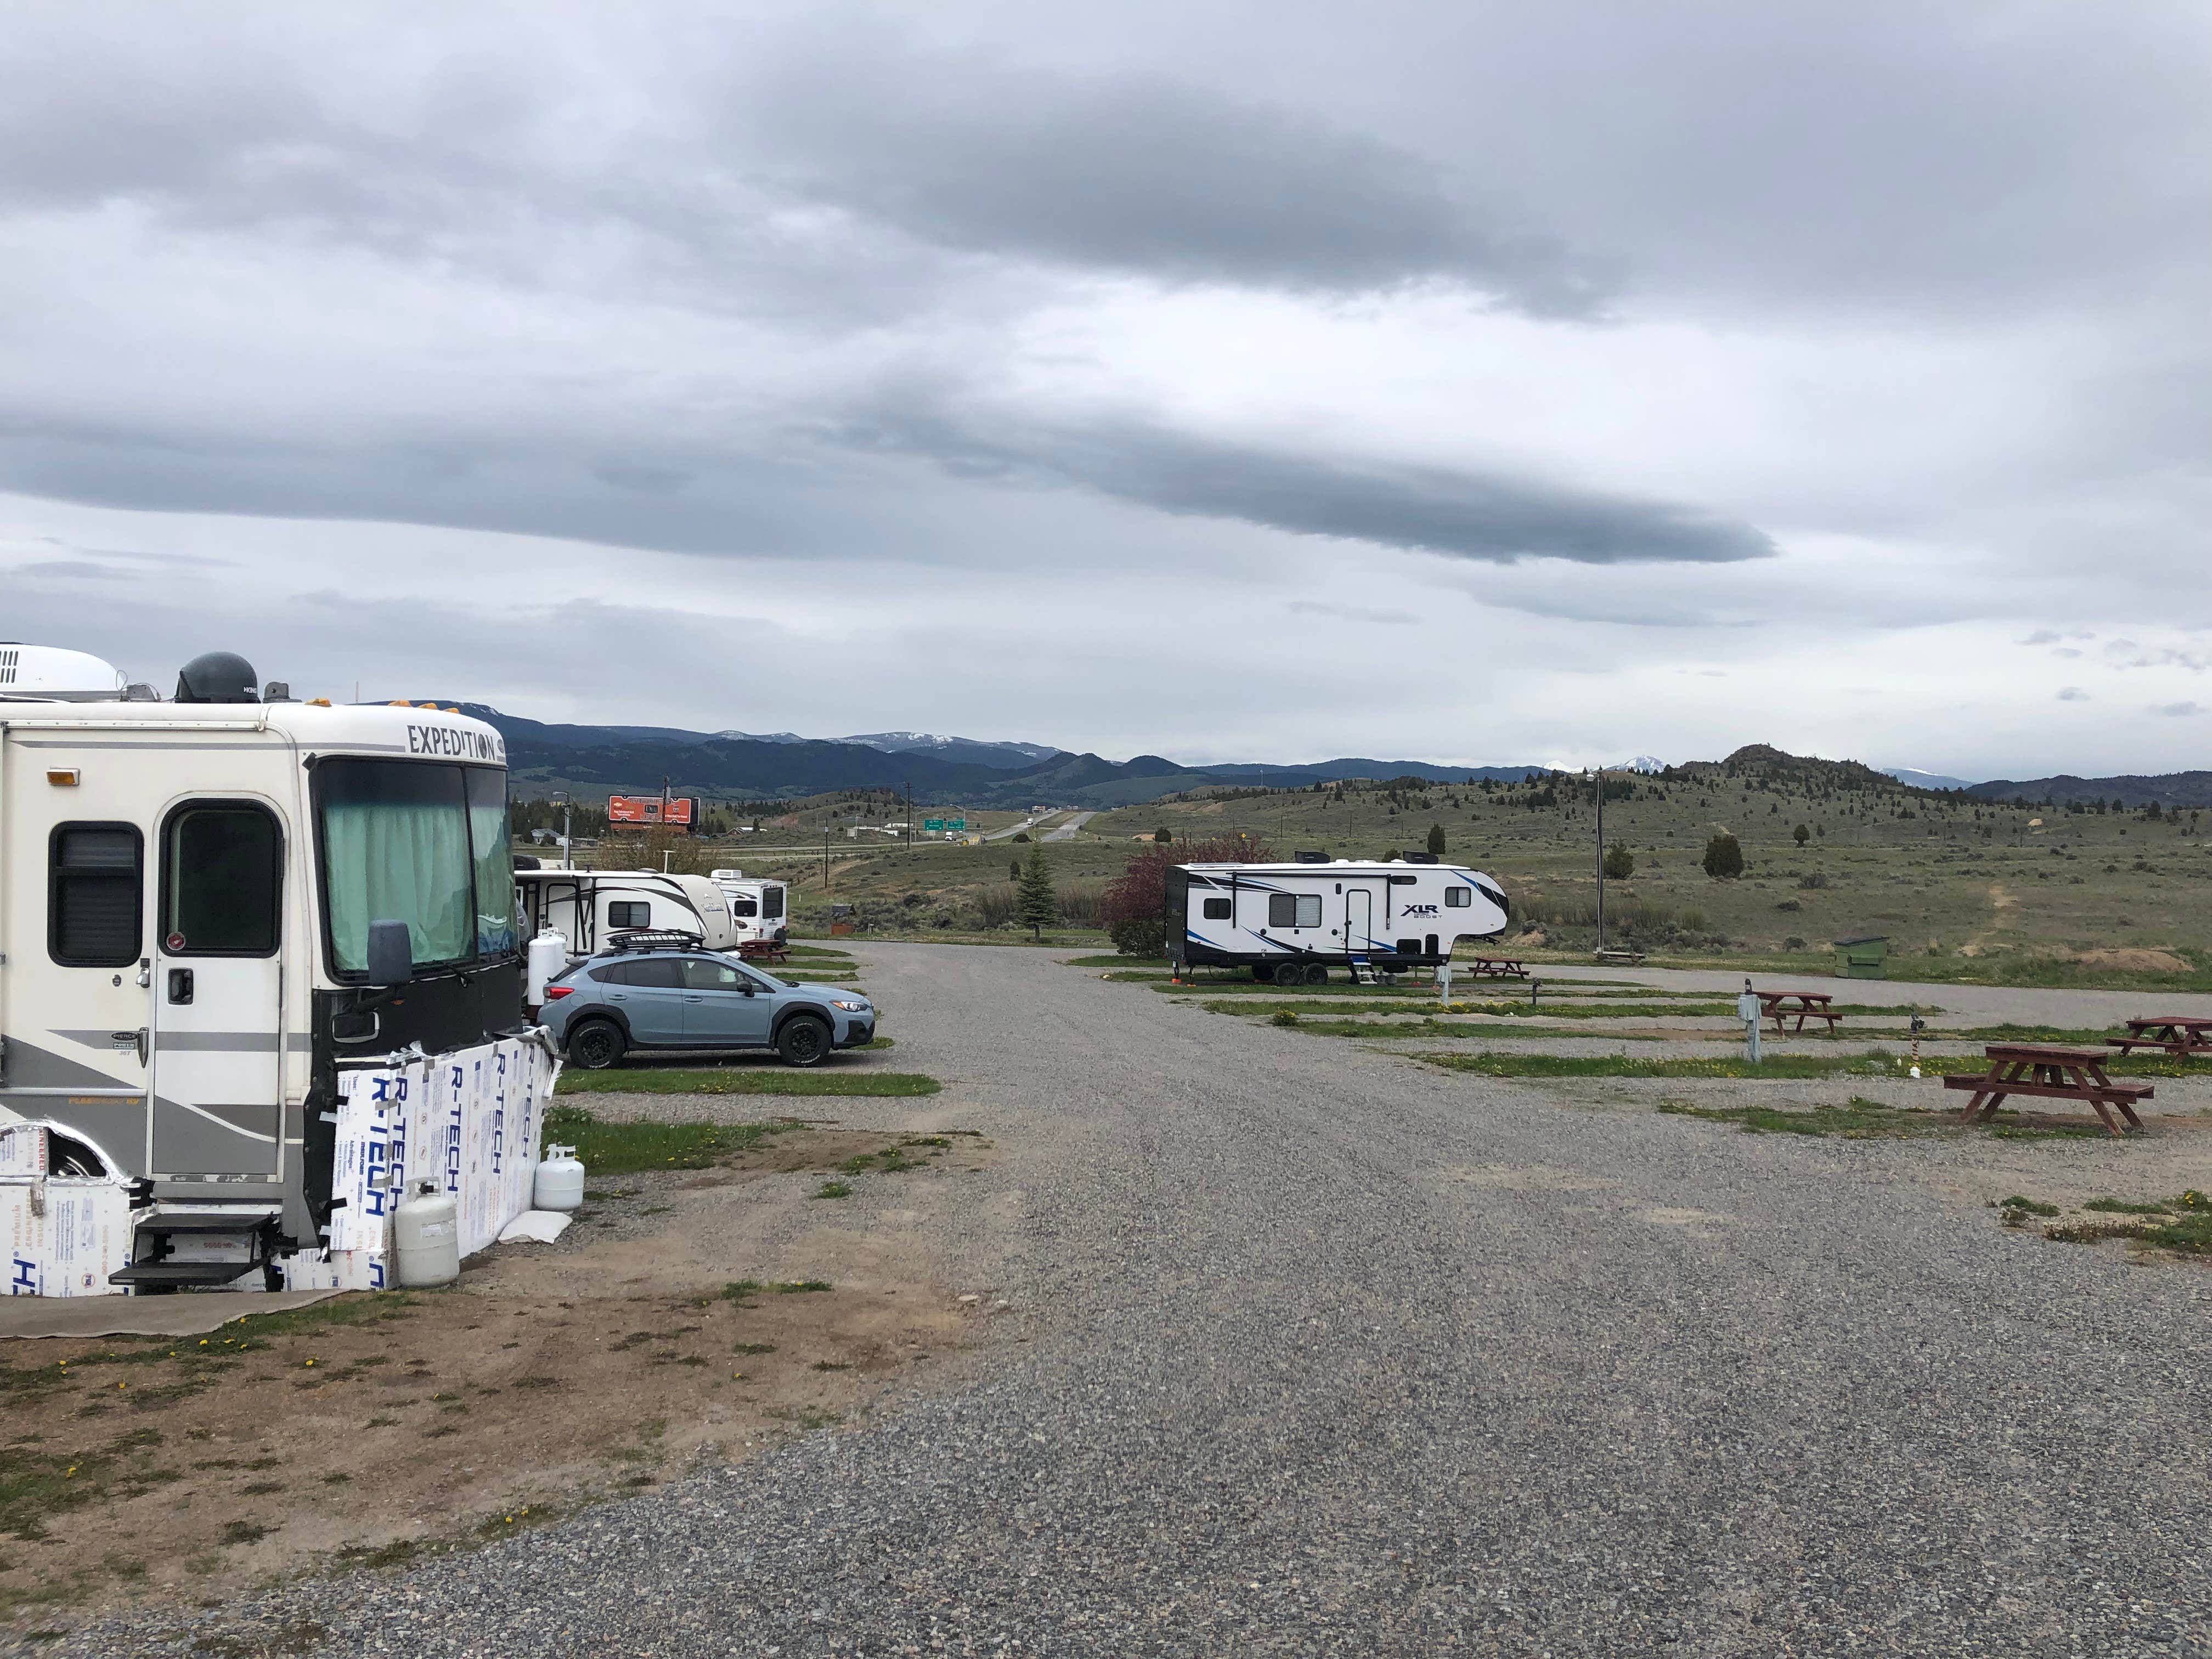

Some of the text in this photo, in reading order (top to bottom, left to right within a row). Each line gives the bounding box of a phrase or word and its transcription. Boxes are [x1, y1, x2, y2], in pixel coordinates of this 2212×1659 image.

[407, 725, 495, 761] EXPEDITION
[1400, 905, 1439, 917] XLR
[390, 1076, 408, 1212] R-TECH
[447, 1066, 462, 1192] R-TECH
[493, 1053, 506, 1173] R-TECH
[522, 1043, 534, 1158] R-TECH
